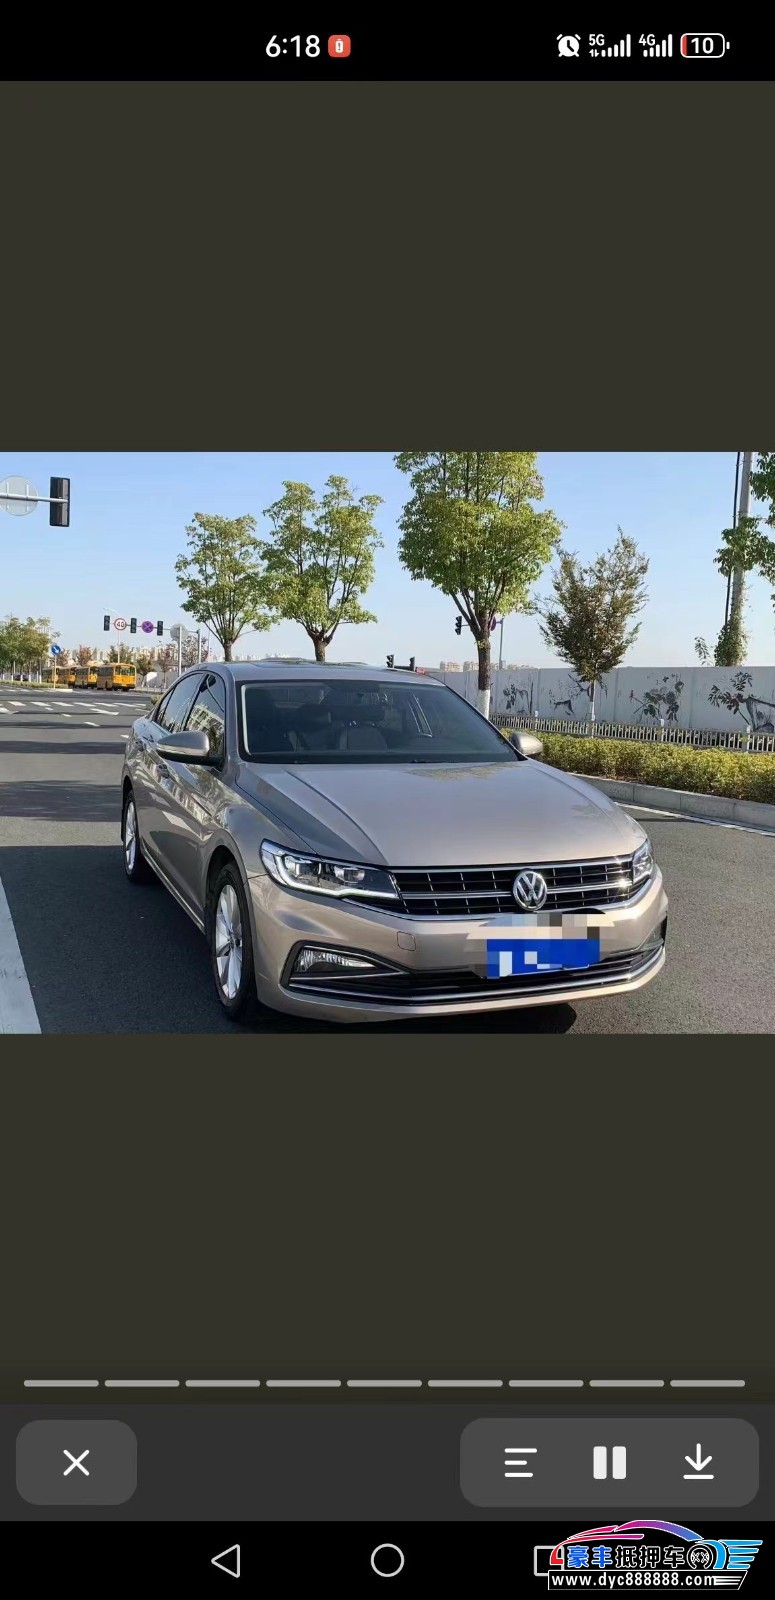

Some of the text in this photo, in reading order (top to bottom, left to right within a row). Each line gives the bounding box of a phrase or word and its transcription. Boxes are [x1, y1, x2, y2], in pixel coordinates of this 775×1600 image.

[265, 35, 320, 58] 6:18
[589, 34, 605, 46] 5G
[638, 34, 656, 46] 4G
[691, 37, 714, 54] 10
